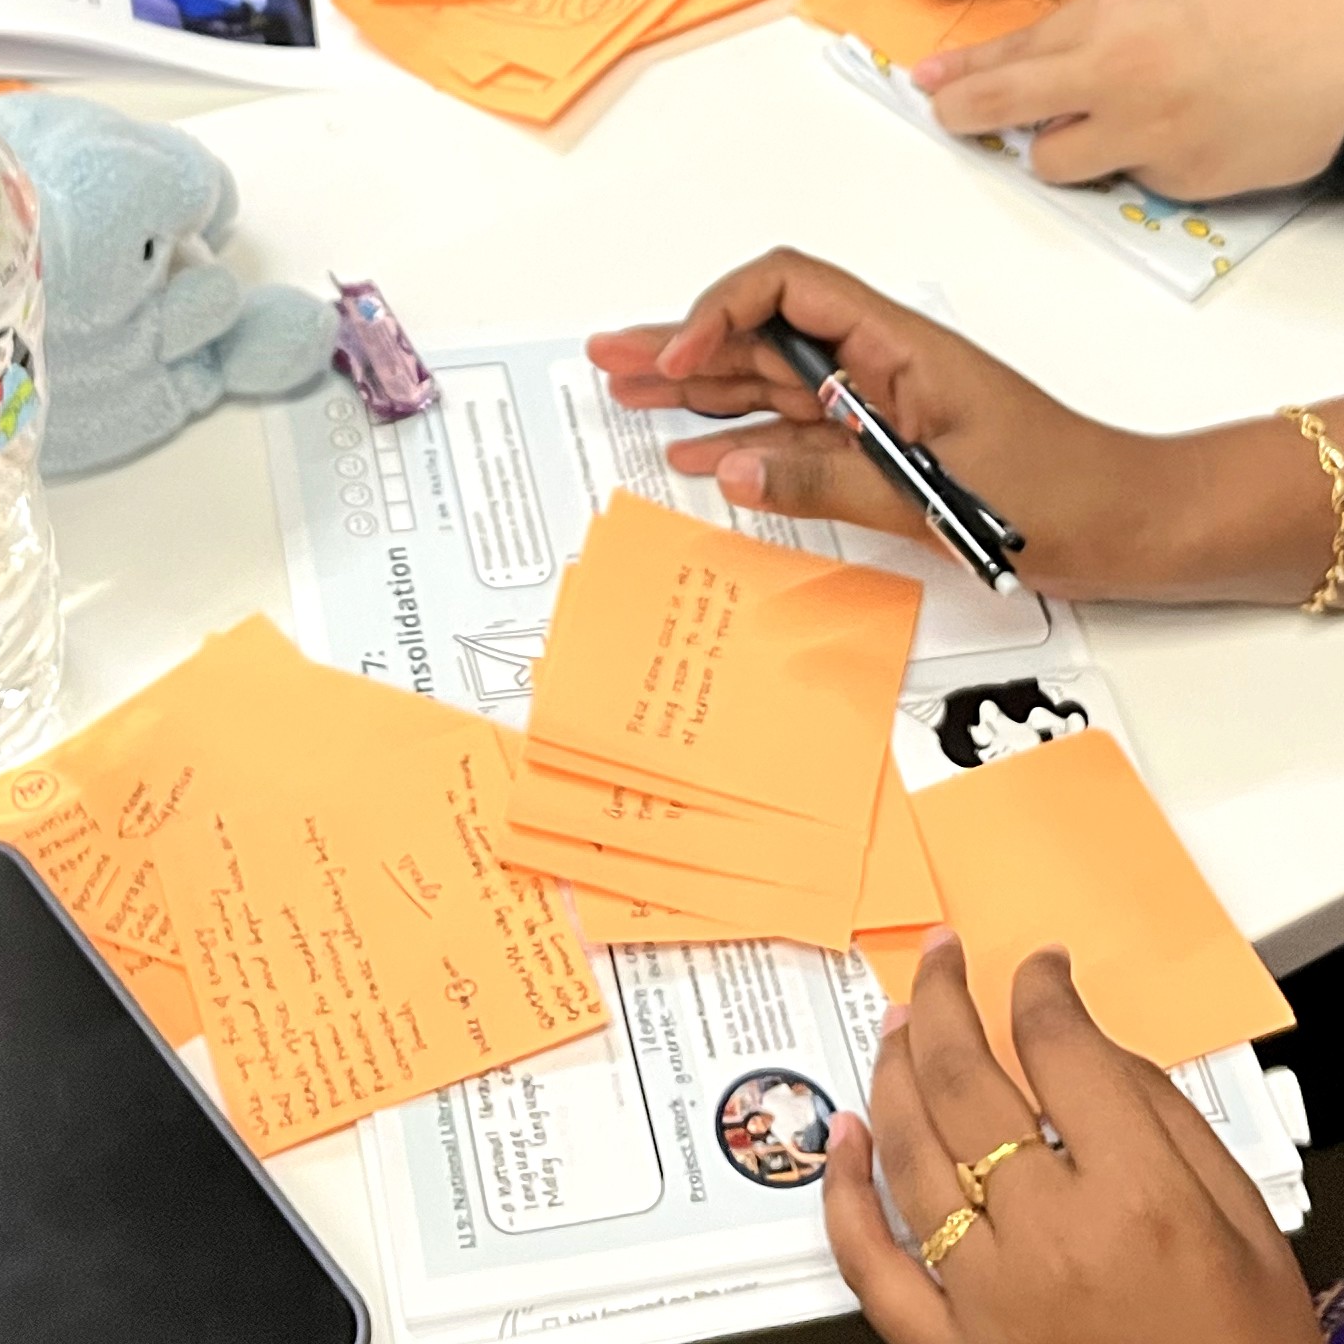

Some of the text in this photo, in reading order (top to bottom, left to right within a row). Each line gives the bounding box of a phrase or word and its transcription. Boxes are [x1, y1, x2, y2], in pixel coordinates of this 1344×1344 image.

[361, 651, 388, 676] 7:
[387, 547, 435, 703] nsolidation
[441, 1137, 468, 1211] National
[510, 1129, 539, 1210] language
[542, 1158, 564, 1208] Malay
[668, 1097, 707, 1203] Project Work
